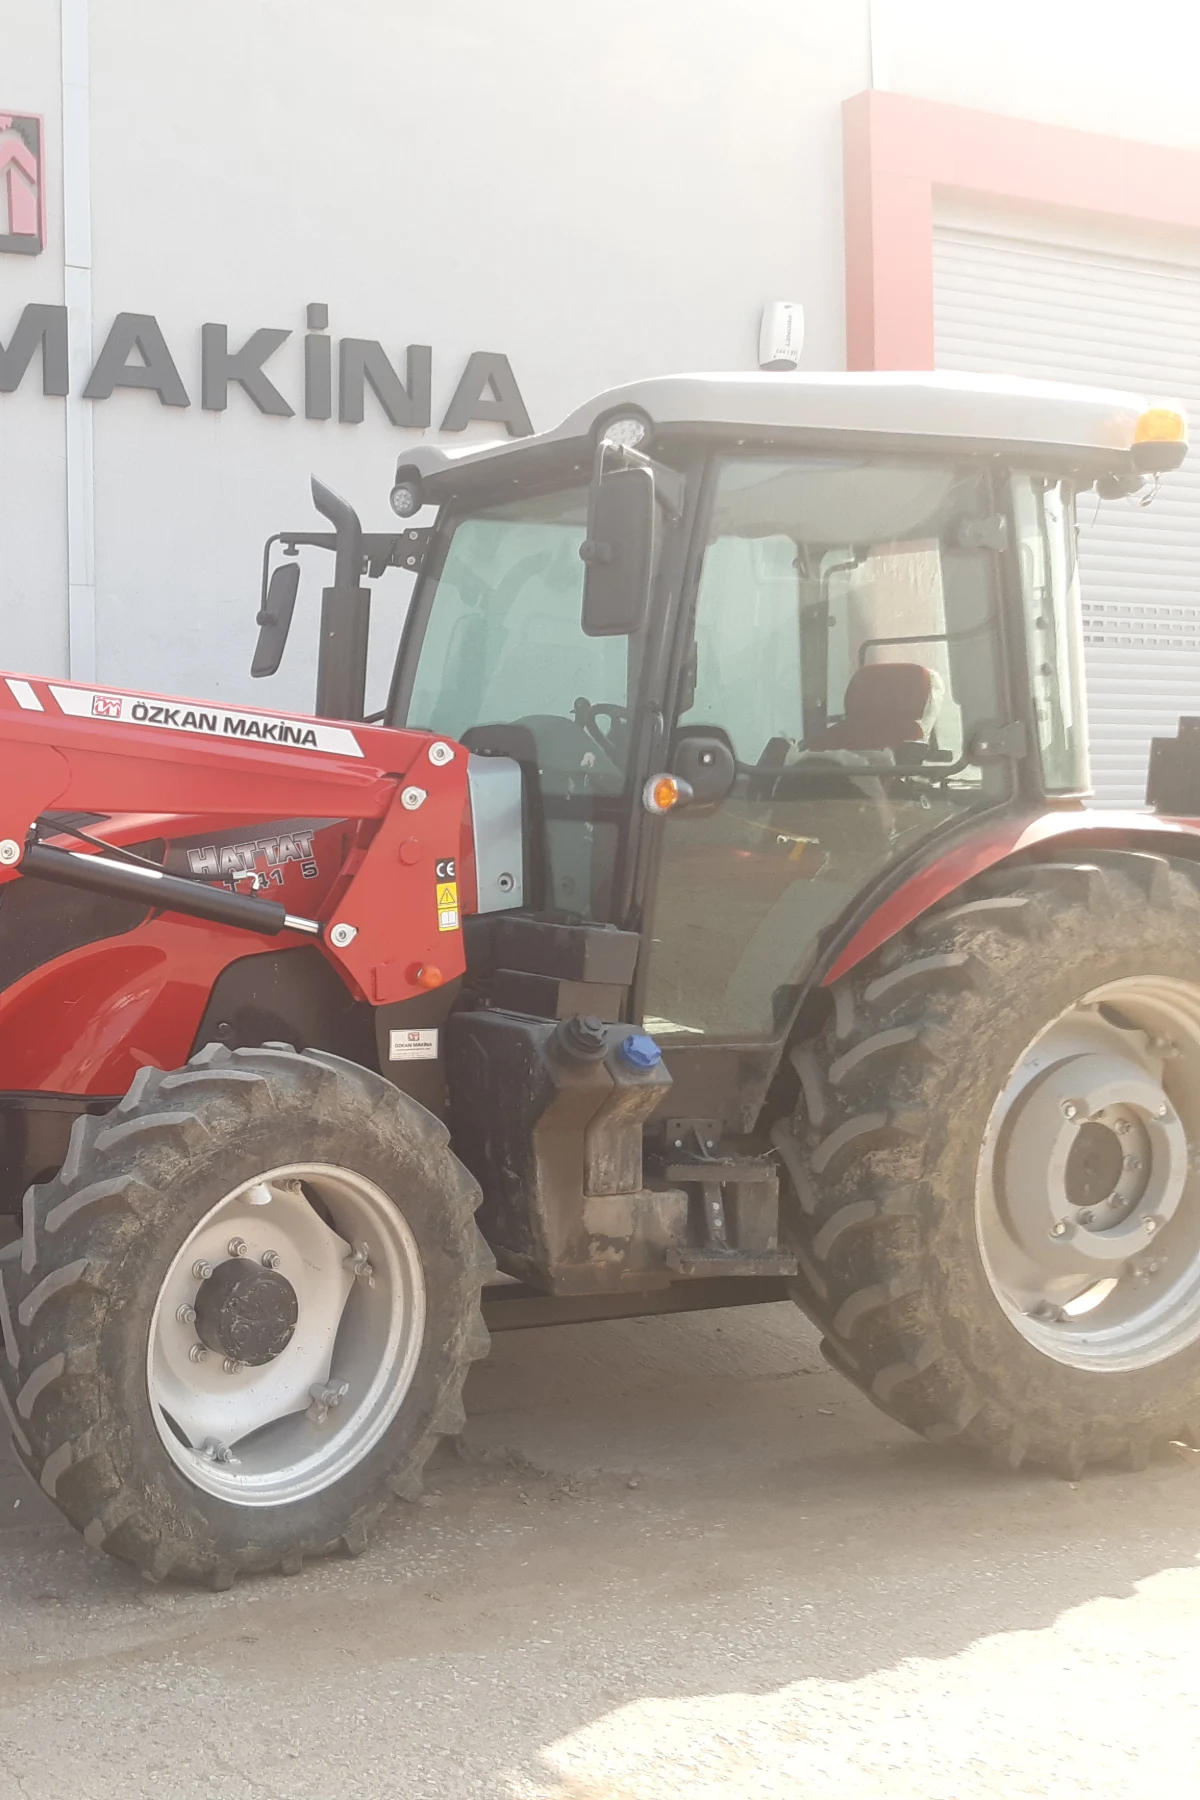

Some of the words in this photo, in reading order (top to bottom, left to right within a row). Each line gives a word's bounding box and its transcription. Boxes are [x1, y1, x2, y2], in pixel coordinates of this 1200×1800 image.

[131, 701, 217, 731] ÖZKAN
[223, 717, 318, 748] MAKİNA
[187, 830, 314, 874] HATTAT
[436, 861, 455, 878] CE
